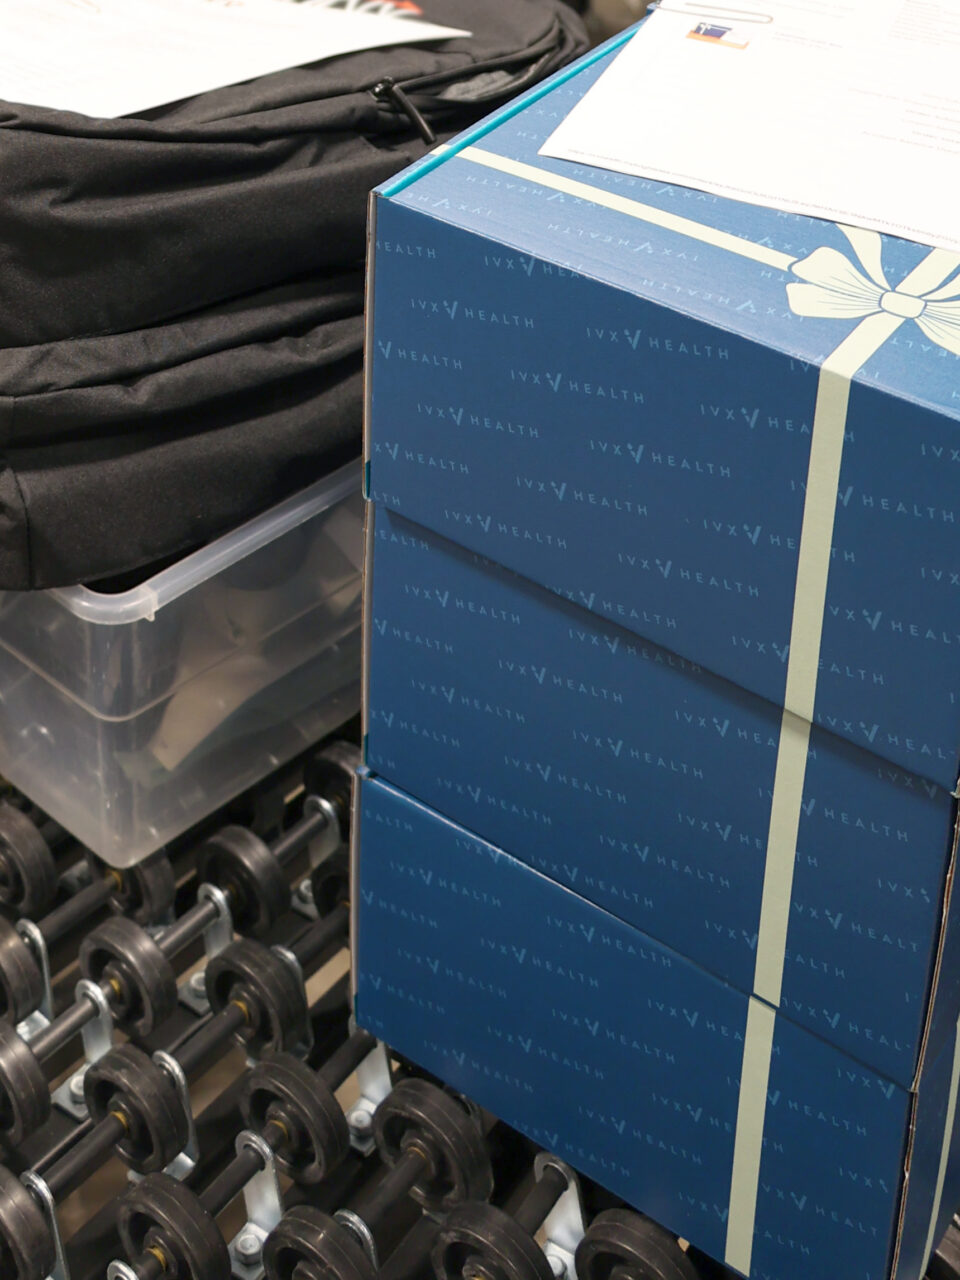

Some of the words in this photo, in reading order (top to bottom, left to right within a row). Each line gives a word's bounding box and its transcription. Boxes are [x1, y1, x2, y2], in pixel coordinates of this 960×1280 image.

[466, 175, 543, 195] HEALTH
[459, 203, 494, 217] IVX
[547, 222, 629, 247] HEALTH
[484, 255, 515, 270] IVX
[661, 245, 700, 261] IVX
[642, 278, 732, 304] HEALTH
[411, 298, 438, 314] IVX
[464, 307, 535, 329] HEALTH
[399, 347, 463, 371] HEALTH
[586, 327, 619, 344] IVX
[648, 337, 730, 361] HEALTH
[511, 368, 541, 386] IVX
[568, 379, 645, 405] HEALTH
[418, 401, 444, 420] IVX
[470, 414, 540, 439] HEALTH
[701, 403, 737, 421] IVX
[404, 449, 471, 476] HEALTH
[589, 439, 622, 456] IVX
[651, 450, 732, 479] HEALTH
[516, 475, 546, 494] IVX
[573, 487, 648, 518] HEALTH
[863, 494, 955, 524] HEALTH
[445, 509, 473, 528] IVX
[499, 521, 568, 551] HEALTH
[703, 518, 739, 537] IVX
[618, 552, 649, 571] IVX
[680, 567, 760, 599] HEALTH
[404, 582, 430, 601] IVX
[456, 597, 521, 626] HEALTH
[601, 600, 678, 630] HEALTH
[392, 626, 454, 655] HEALTH
[568, 627, 600, 647] IVX
[731, 634, 768, 655] IVX
[498, 659, 528, 680] IVX
[552, 673, 624, 705] HEALTH
[410, 679, 438, 698] IVX
[460, 695, 527, 726] HEALTH
[673, 709, 708, 729] IVX
[399, 717, 461, 750] HEALTH
[572, 728, 603, 749] IVX
[628, 747, 703, 780] HEALTH
[503, 753, 533, 774] IVX
[557, 772, 628, 806] HEALTH
[878, 767, 913, 789] IVX
[436, 776, 464, 796] IVX
[486, 793, 552, 825] HEALTH
[676, 812, 710, 833] IVX
[823, 806, 909, 842] HEALTH
[599, 833, 629, 854] IVX
[657, 853, 731, 890] HEALTH
[387, 859, 416, 878] IVX
[439, 876, 502, 909] HEALTH
[530, 854, 559, 875] IVX
[584, 874, 653, 910] HEALTH
[878, 877, 913, 900] IVX
[379, 897, 439, 930] HEALTH
[702, 919, 736, 940] IVX
[546, 914, 576, 935] IVX
[601, 934, 673, 969] HEALTH
[397, 946, 423, 966] IVX
[445, 964, 508, 1001] HEALTH
[480, 936, 509, 957] IVX
[531, 955, 600, 991] HEALTH
[647, 996, 678, 1018] IVX
[780, 995, 818, 1019] IVX
[488, 1024, 514, 1044] IVX
[539, 1043, 606, 1081] HEALTH
[551, 1007, 580, 1027] IVX
[605, 1027, 676, 1065] HEALTH
[423, 1039, 449, 1058] IVX
[471, 1058, 534, 1095] HEALTH
[836, 1066, 872, 1090] IVX
[651, 1092, 682, 1113] IVX
[787, 1097, 868, 1137] HEALTH
[577, 1104, 607, 1125] IVX
[632, 1126, 703, 1166] HEALTH
[564, 1141, 631, 1179] HEALTH
[838, 1164, 873, 1189] IVX
[678, 1190, 710, 1213] IVX
